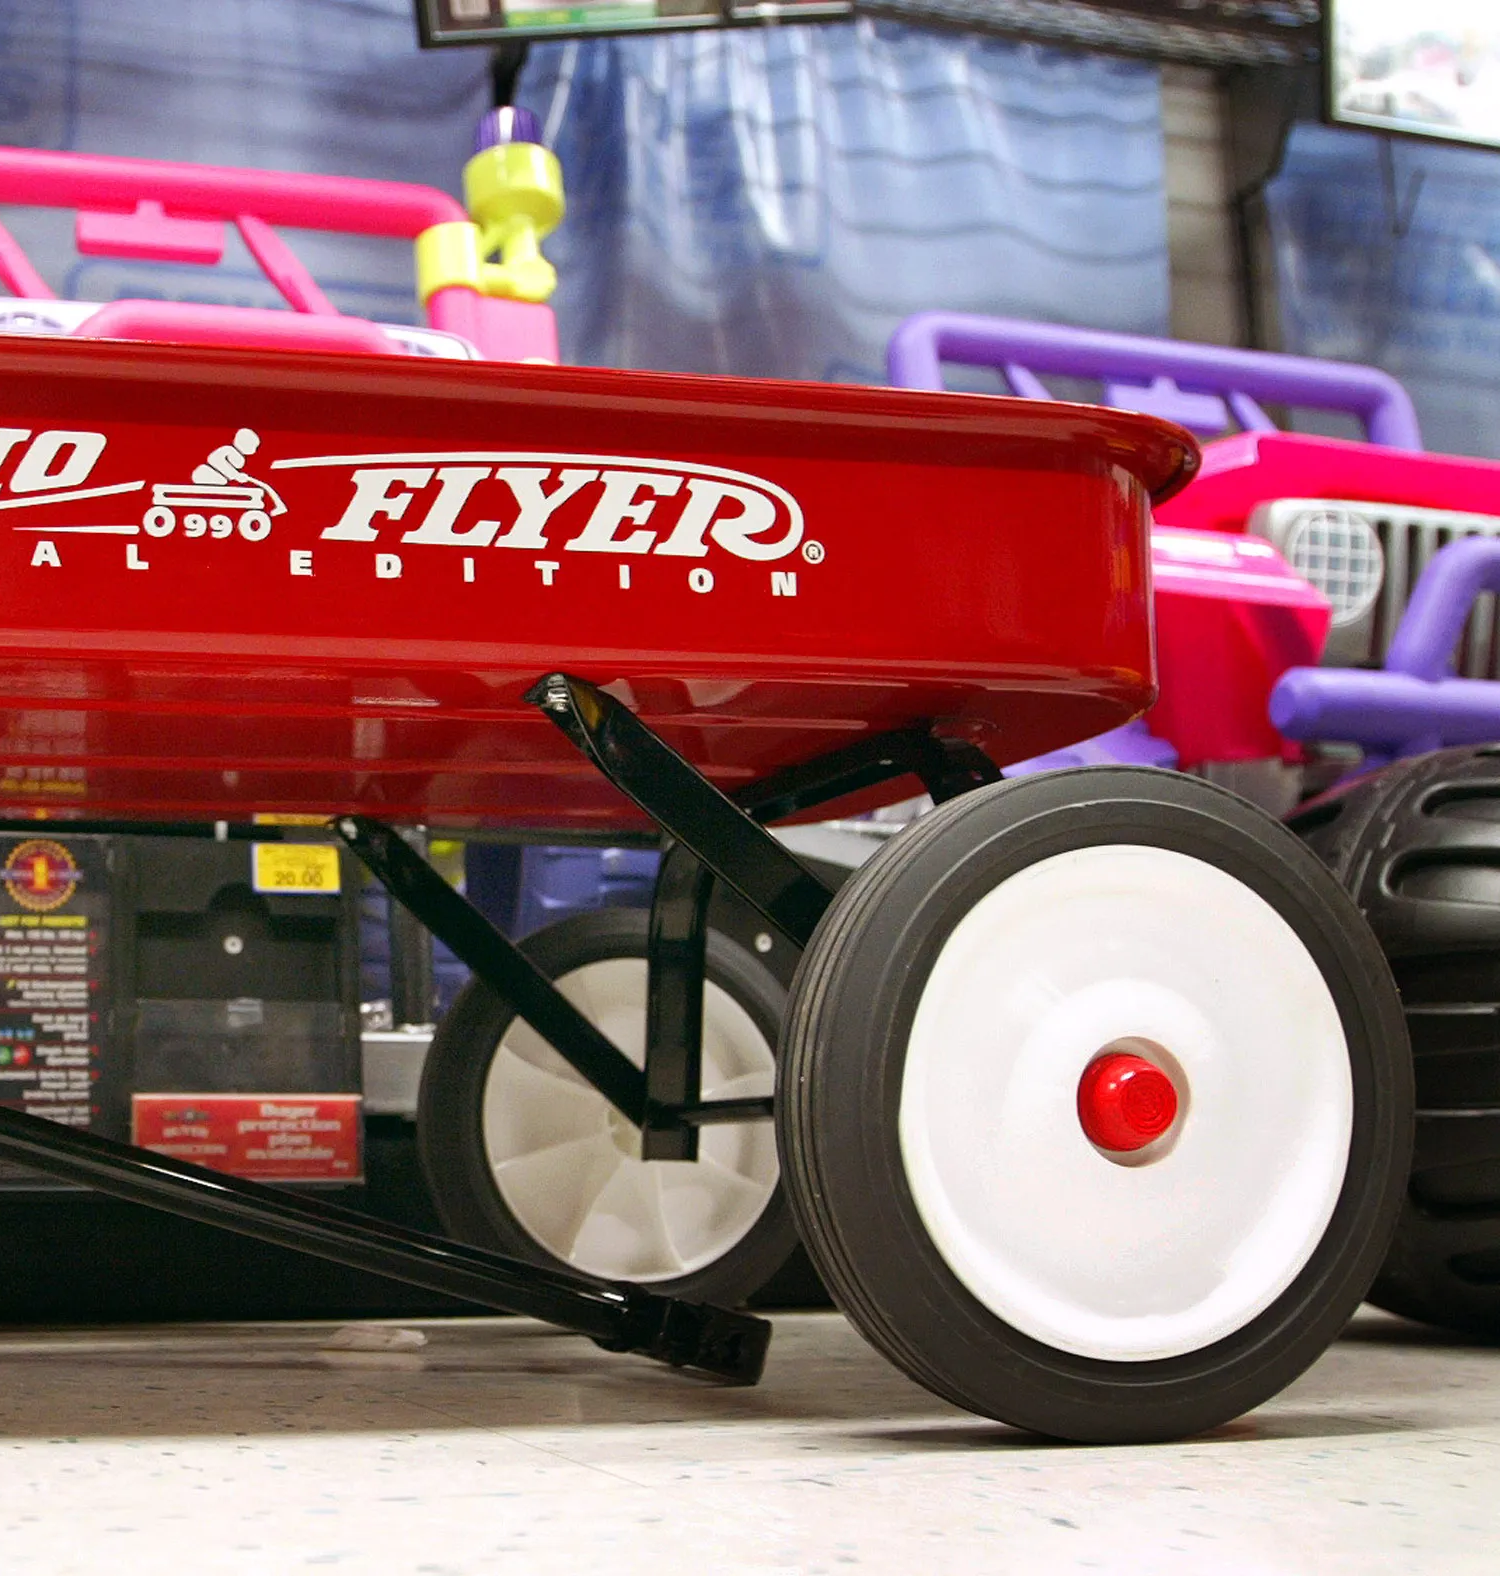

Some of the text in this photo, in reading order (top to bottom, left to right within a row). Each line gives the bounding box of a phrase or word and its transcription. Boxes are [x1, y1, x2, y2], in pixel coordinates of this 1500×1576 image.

[315, 460, 804, 561] FLYER
[289, 549, 798, 597] EDITION
[259, 1102, 317, 1120] Buyer
[237, 1118, 341, 1135] protection
[267, 1133, 313, 1149] plan
